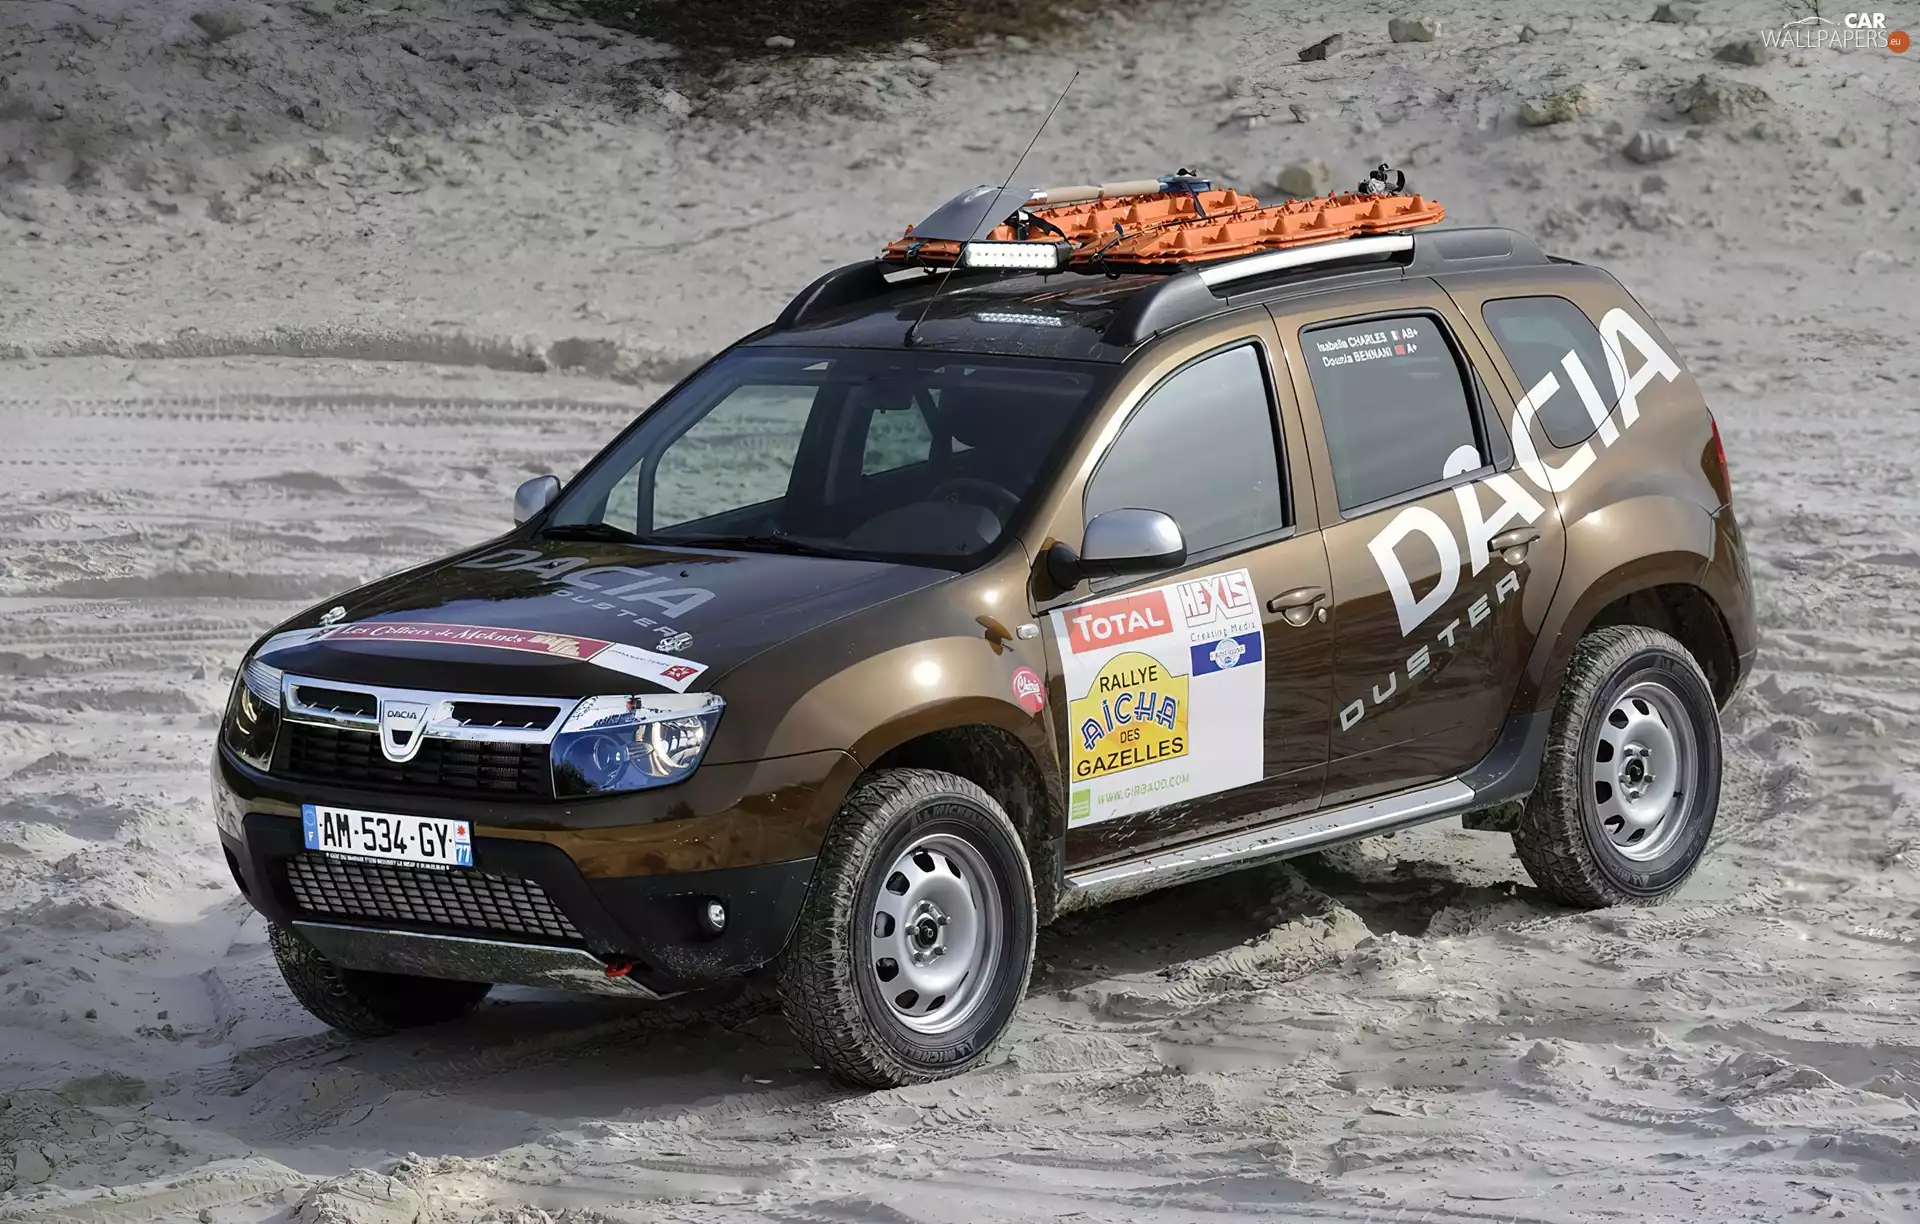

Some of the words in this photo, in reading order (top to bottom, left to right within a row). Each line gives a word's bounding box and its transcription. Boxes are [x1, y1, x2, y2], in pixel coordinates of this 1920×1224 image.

[1347, 331, 1388, 347] CHARLES
[1366, 307, 1681, 637] DACIA
[453, 549, 716, 619] DACIA
[1177, 572, 1253, 626] HEXIS
[551, 588, 681, 638] DUSTER
[1071, 607, 1165, 642] TOTAL
[1339, 570, 1521, 732] DUSTER
[1099, 665, 1158, 693] RALLYE
[387, 710, 417, 720] DACIA
[1120, 727, 1141, 744] DES
[1076, 736, 1184, 777] GAZELLES
[456, 846, 470, 864] 77
